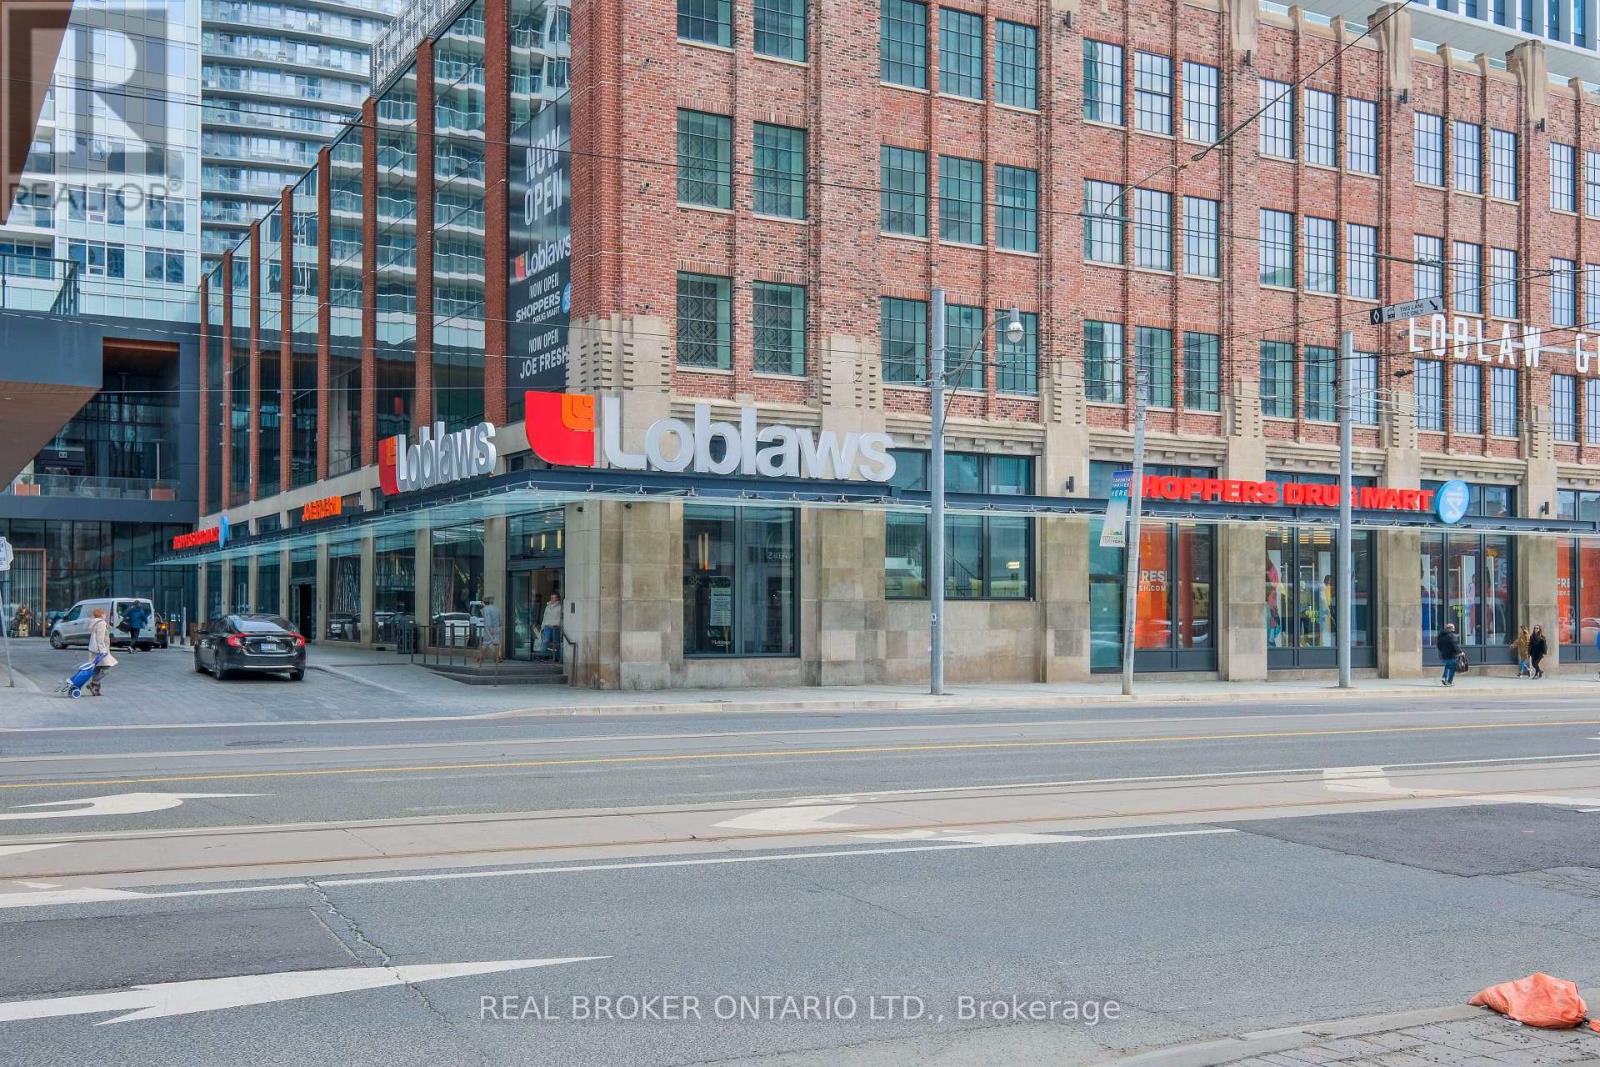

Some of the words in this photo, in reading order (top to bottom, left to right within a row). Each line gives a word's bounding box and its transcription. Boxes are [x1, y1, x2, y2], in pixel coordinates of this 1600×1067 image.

[526, 125, 560, 183] NOW
[524, 168, 562, 226] OPEN
[525, 234, 571, 278] Loblaws
[529, 280, 543, 299] NOW
[543, 272, 559, 292] OPEN
[516, 291, 560, 322] SHOPPERS
[528, 335, 543, 355] NOW
[543, 328, 559, 348] OPEN
[1409, 314, 1541, 367] LOBLAW
[1576, 333, 1600, 374] G
[520, 357, 537, 379] JOE
[539, 345, 568, 373] FRESH
[396, 421, 497, 492] Loblaws
[603, 396, 897, 482] Loblaws
[1360, 487, 1434, 511] MART
[1141, 570, 1168, 582] RES
